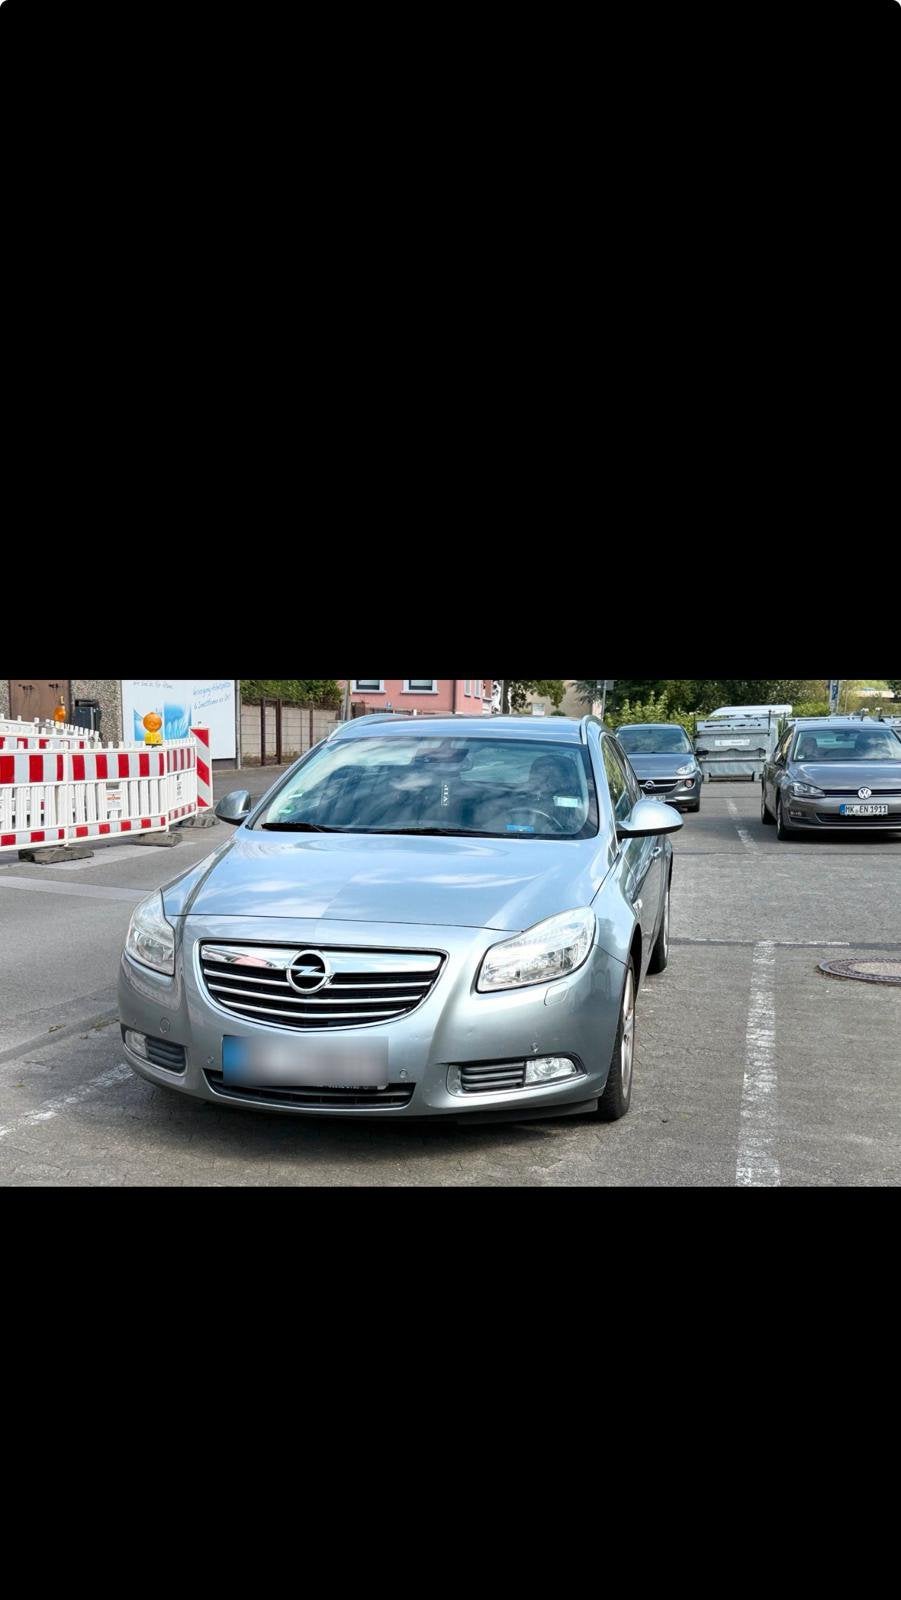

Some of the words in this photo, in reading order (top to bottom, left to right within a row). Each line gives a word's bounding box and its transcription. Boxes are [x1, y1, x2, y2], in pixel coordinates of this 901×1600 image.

[846, 805, 855, 813] MK
[860, 805, 869, 813] EN
[870, 805, 887, 813] 1911
